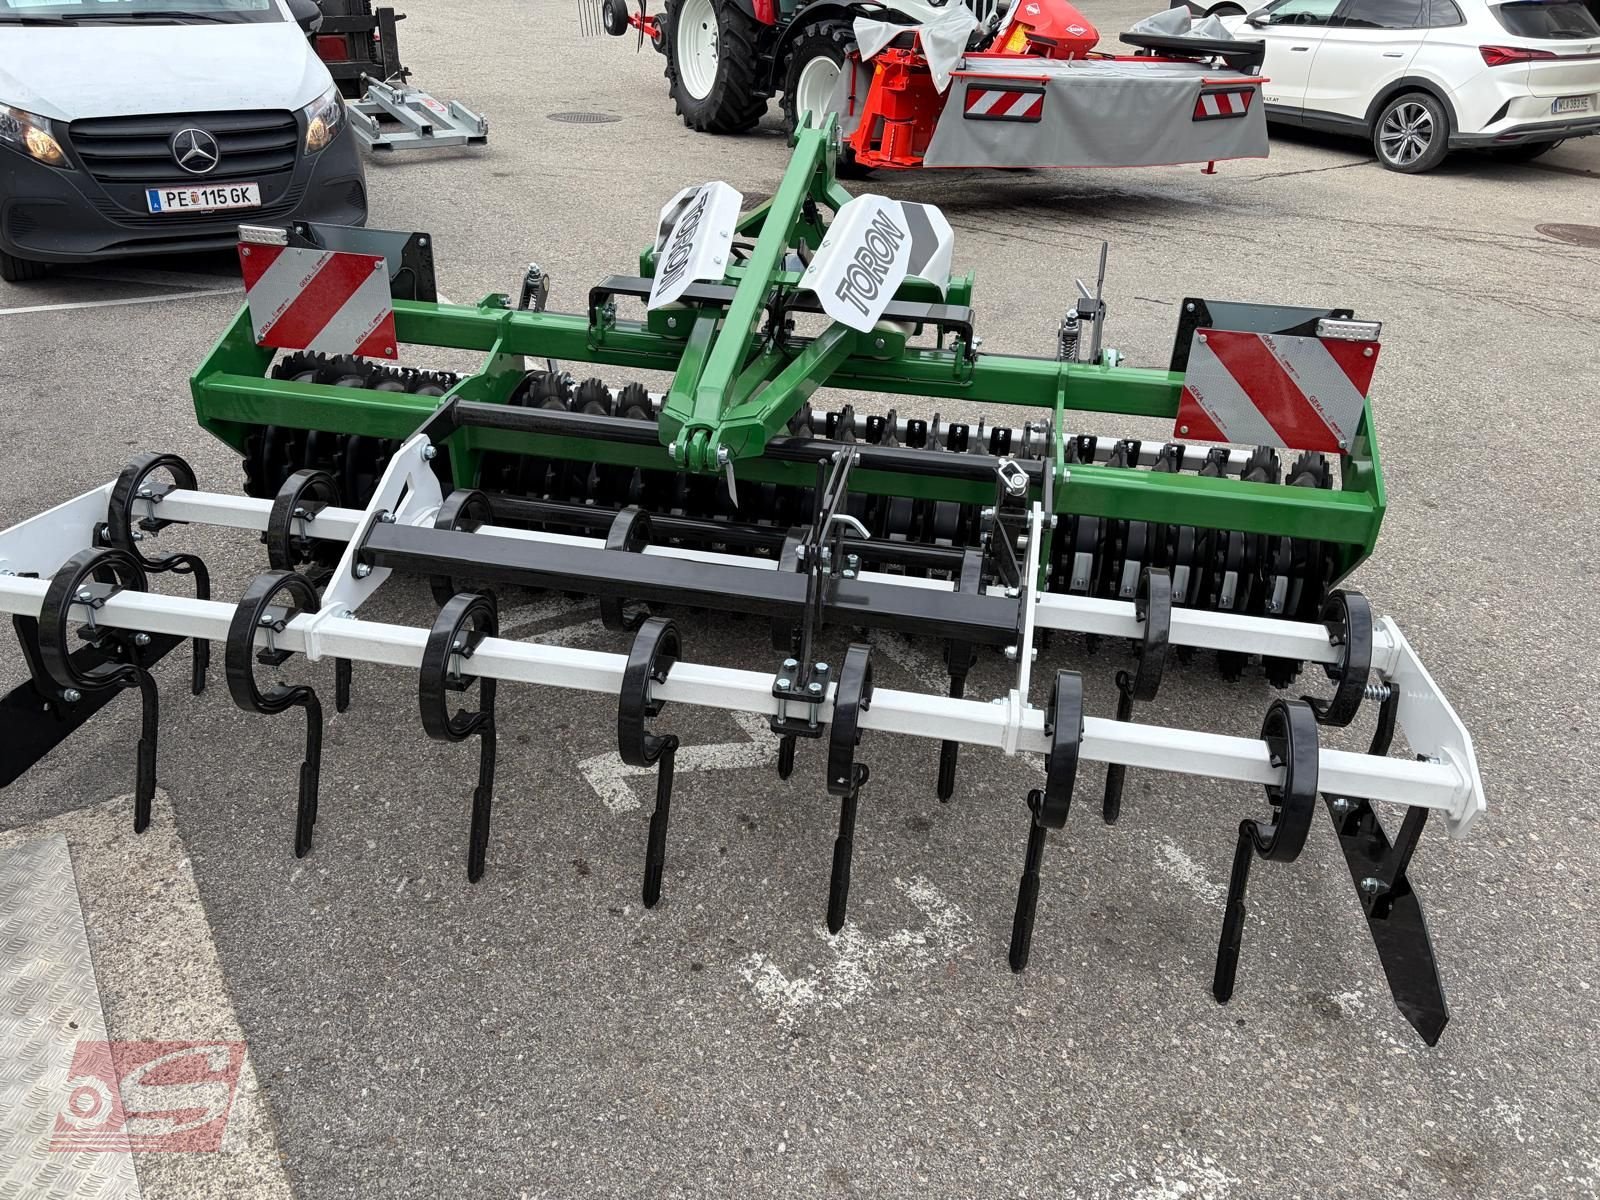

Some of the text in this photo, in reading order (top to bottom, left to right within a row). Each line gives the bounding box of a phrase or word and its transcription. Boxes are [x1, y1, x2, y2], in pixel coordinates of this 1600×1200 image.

[166, 187, 251, 207] PE 115 GK
[655, 191, 709, 298] TORON
[835, 208, 906, 317] TORON
[299, 273, 313, 289] GEKA
[355, 330, 369, 345] GEKA
[1262, 334, 1277, 352] GEKA
[1188, 384, 1204, 403] GEKA
[1309, 394, 1325, 413] GEKA
